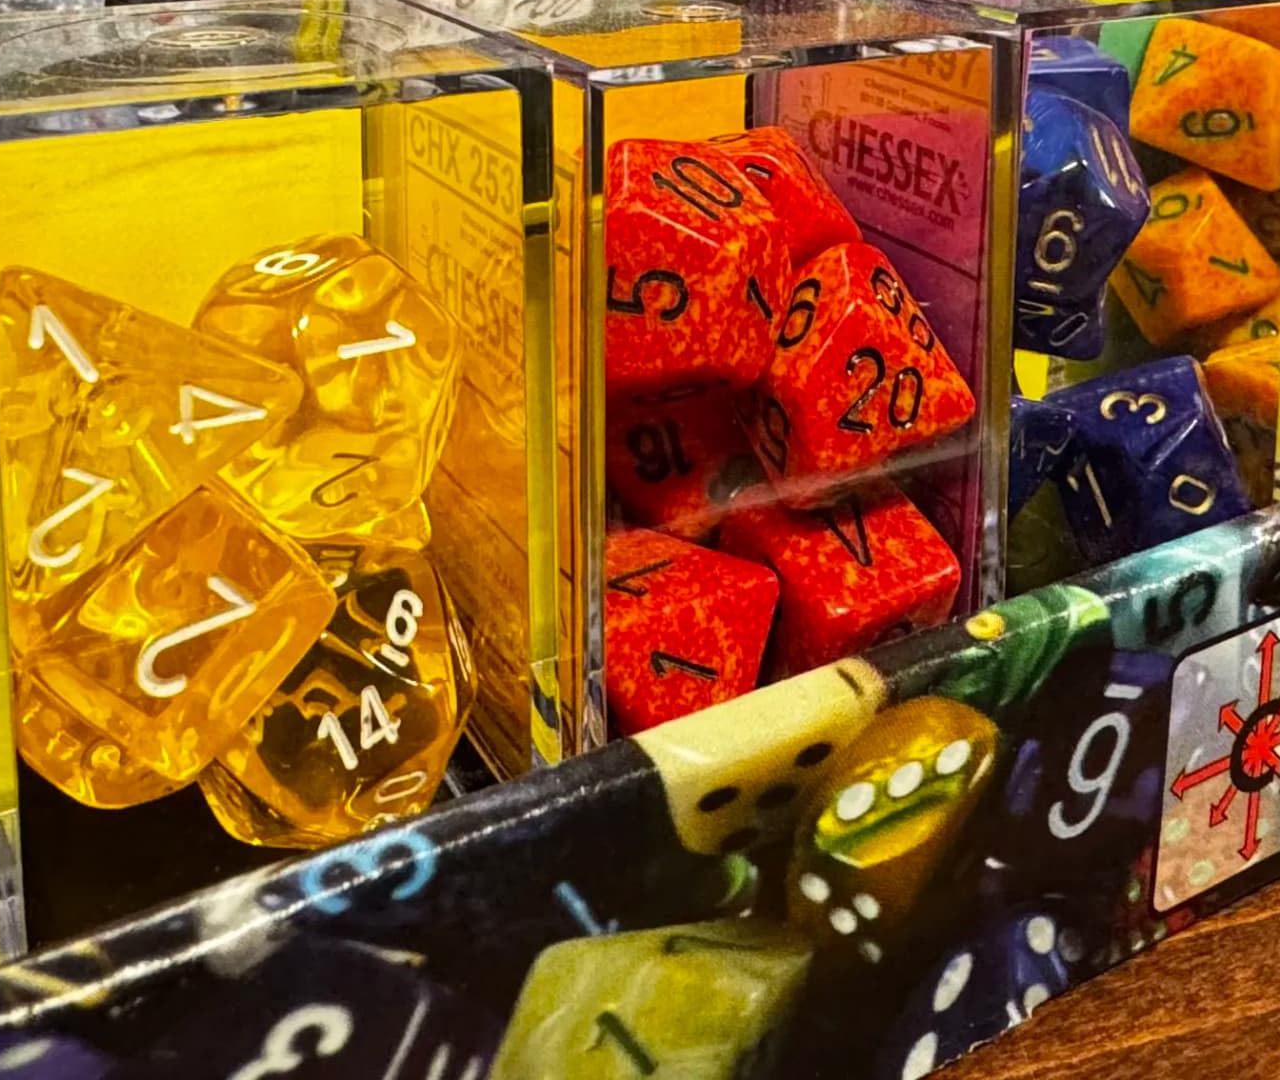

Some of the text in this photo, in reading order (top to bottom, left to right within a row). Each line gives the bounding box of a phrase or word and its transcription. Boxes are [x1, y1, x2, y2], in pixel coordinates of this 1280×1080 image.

[1156, 44, 1198, 87] 4
[410, 112, 462, 187] CHX
[807, 109, 964, 217] CHESSEX
[651, 155, 743, 221] 10
[1034, 208, 1085, 274] 6
[606, 265, 690, 321] 5
[336, 320, 417, 360] 1
[168, 382, 268, 445] 4
[837, 346, 925, 434] 20
[1099, 390, 1168, 427] 3
[28, 466, 115, 569] 2
[135, 575, 258, 699] 2
[383, 589, 425, 647] 6
[318, 684, 402, 772] 14
